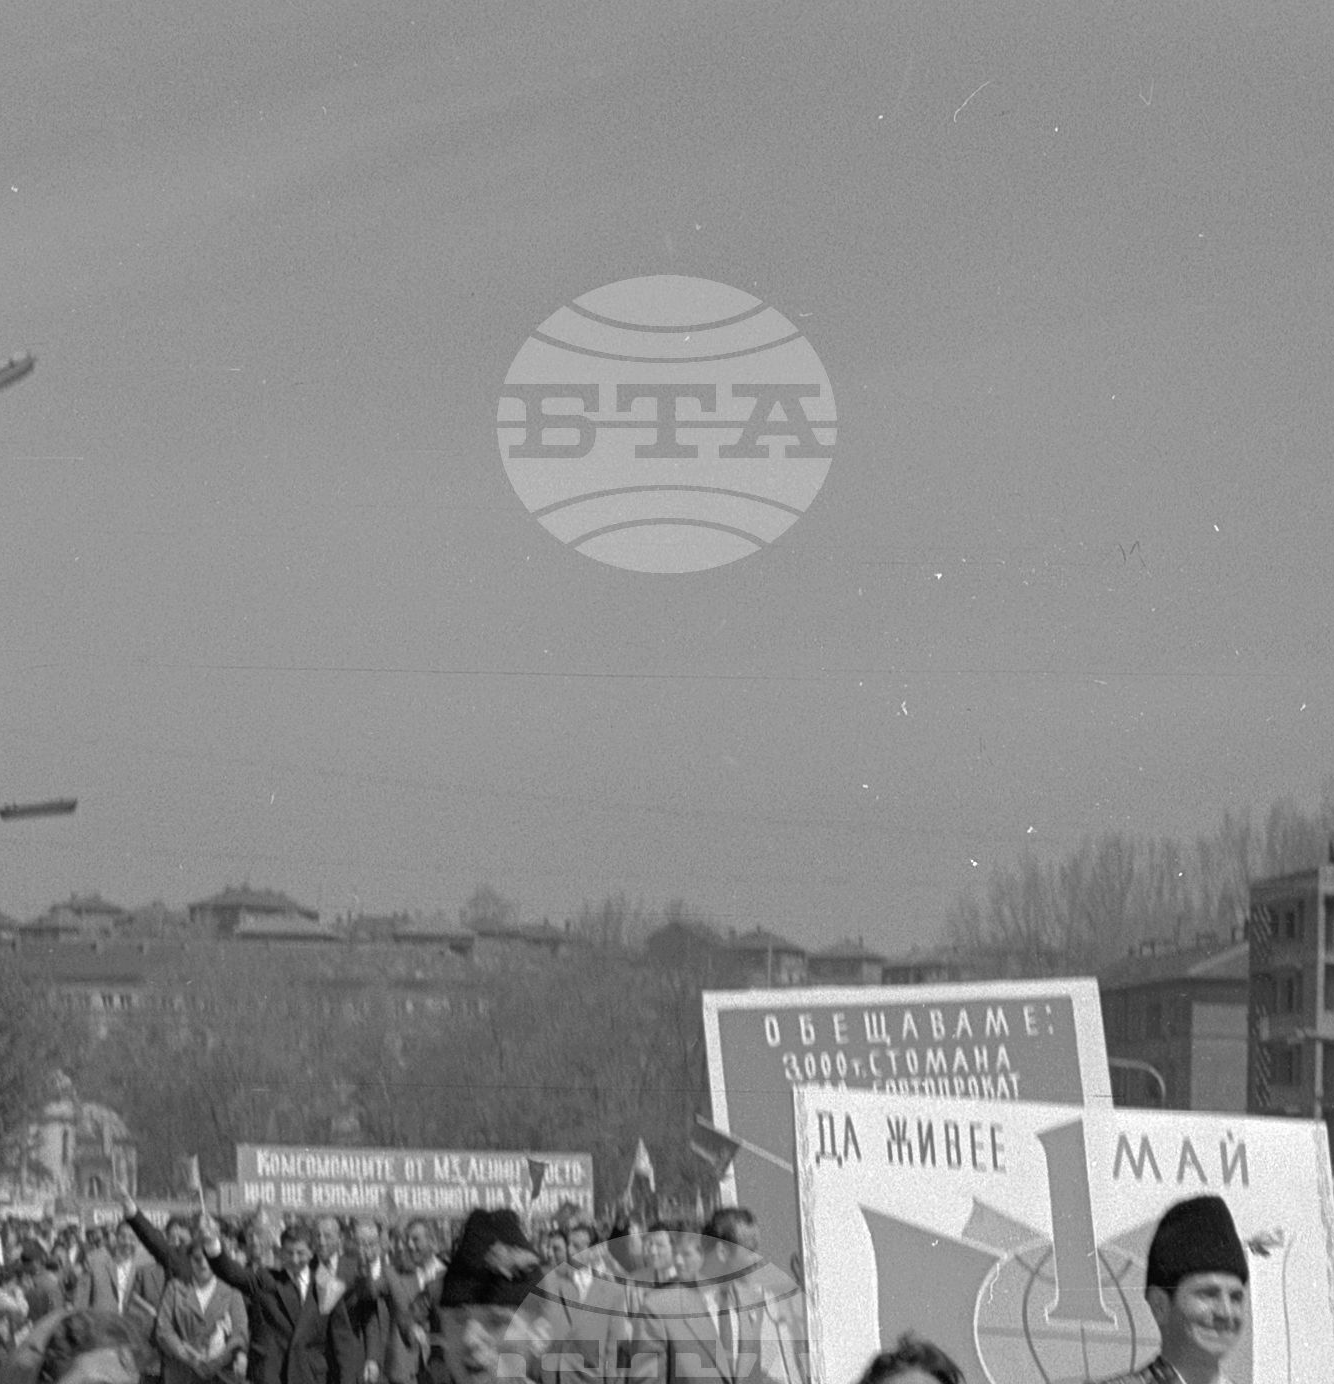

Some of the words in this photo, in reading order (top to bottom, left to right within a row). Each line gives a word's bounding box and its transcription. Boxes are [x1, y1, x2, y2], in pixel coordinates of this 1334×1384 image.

[763, 1003, 1055, 1047] ОБЕЩАВАМЕ:
[870, 1044, 1012, 1079] СТОМАНА
[405, 1156, 426, 1181] ОТ
[815, 1110, 862, 1169] ДА
[886, 1115, 1007, 1173] ЖИВЕЕ
[1113, 1128, 1250, 1188] МАЙ
